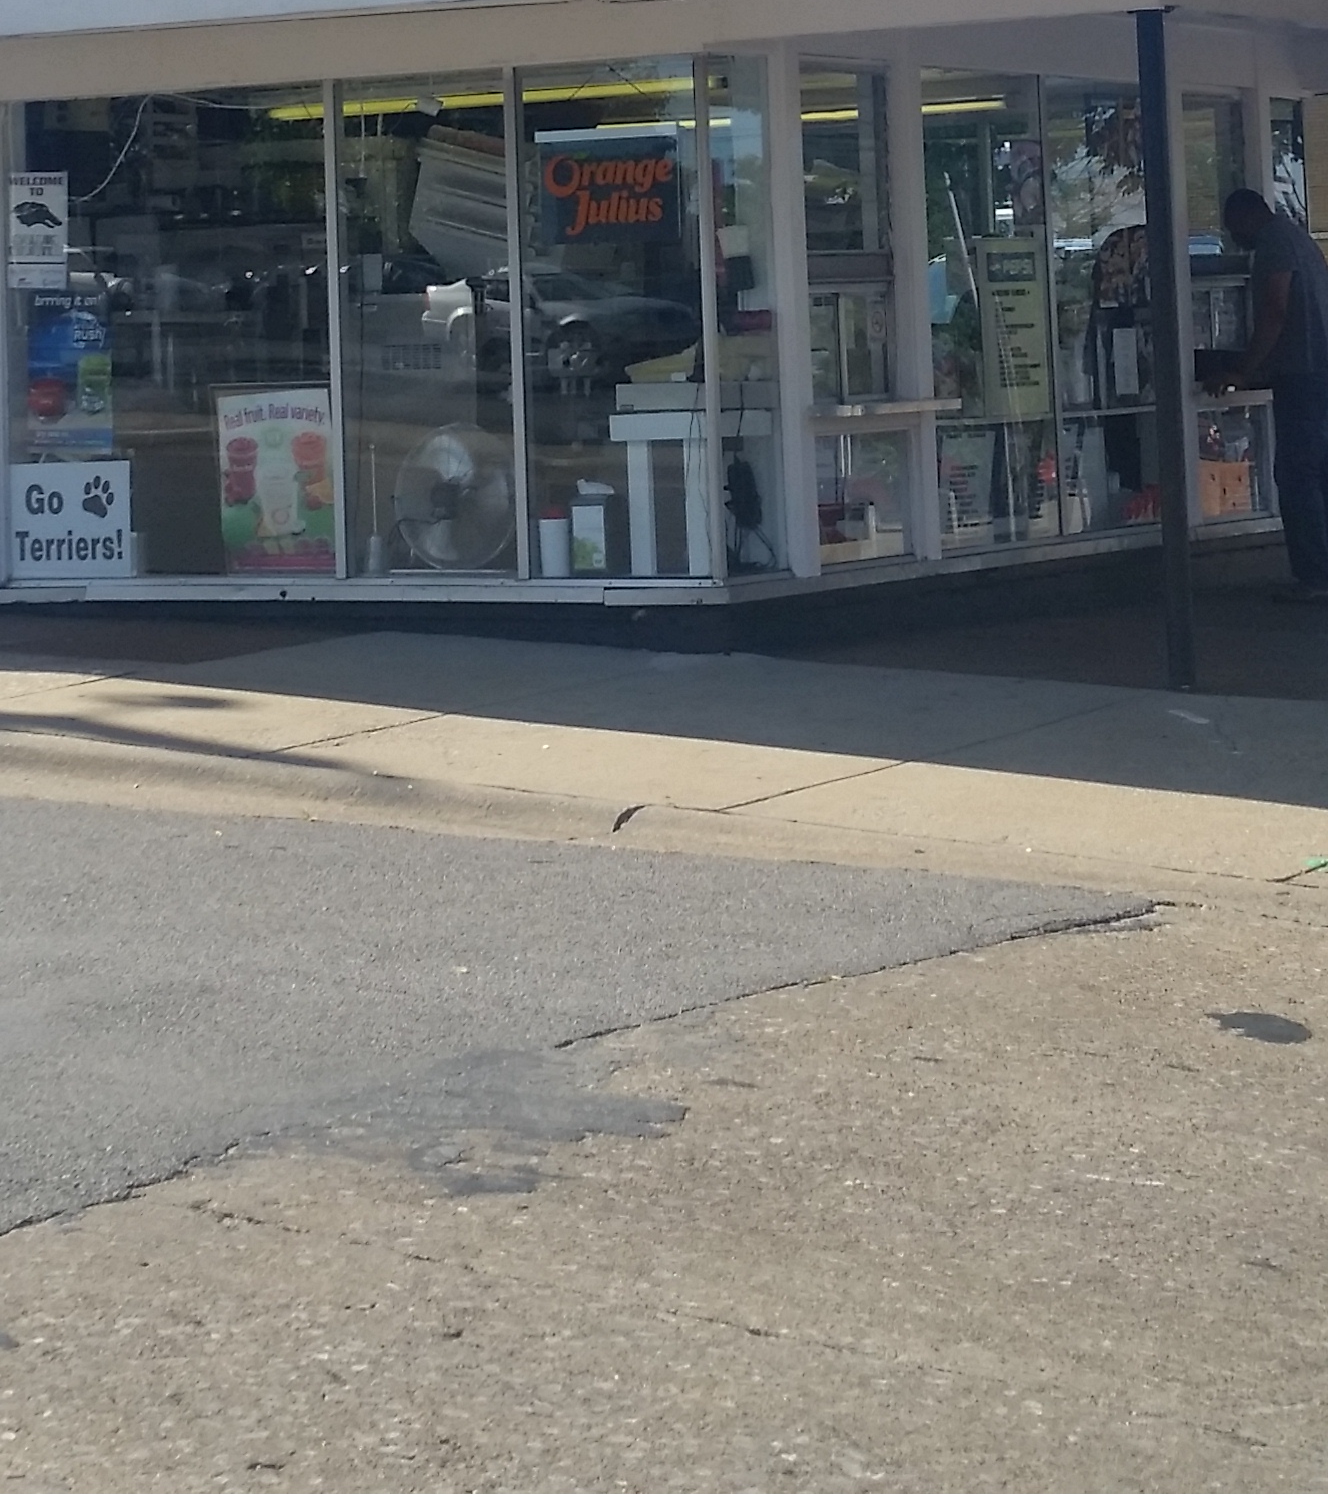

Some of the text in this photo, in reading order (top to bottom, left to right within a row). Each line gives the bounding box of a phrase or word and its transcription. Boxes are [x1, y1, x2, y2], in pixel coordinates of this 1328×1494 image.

[9, 176, 64, 186] WELCOME
[29, 187, 45, 196] TO
[544, 155, 673, 198] Orange
[565, 189, 664, 236] Julius
[224, 411, 244, 430] Real
[268, 403, 289, 420] Real
[25, 484, 64, 515] Go
[15, 529, 123, 561] Terriers!
